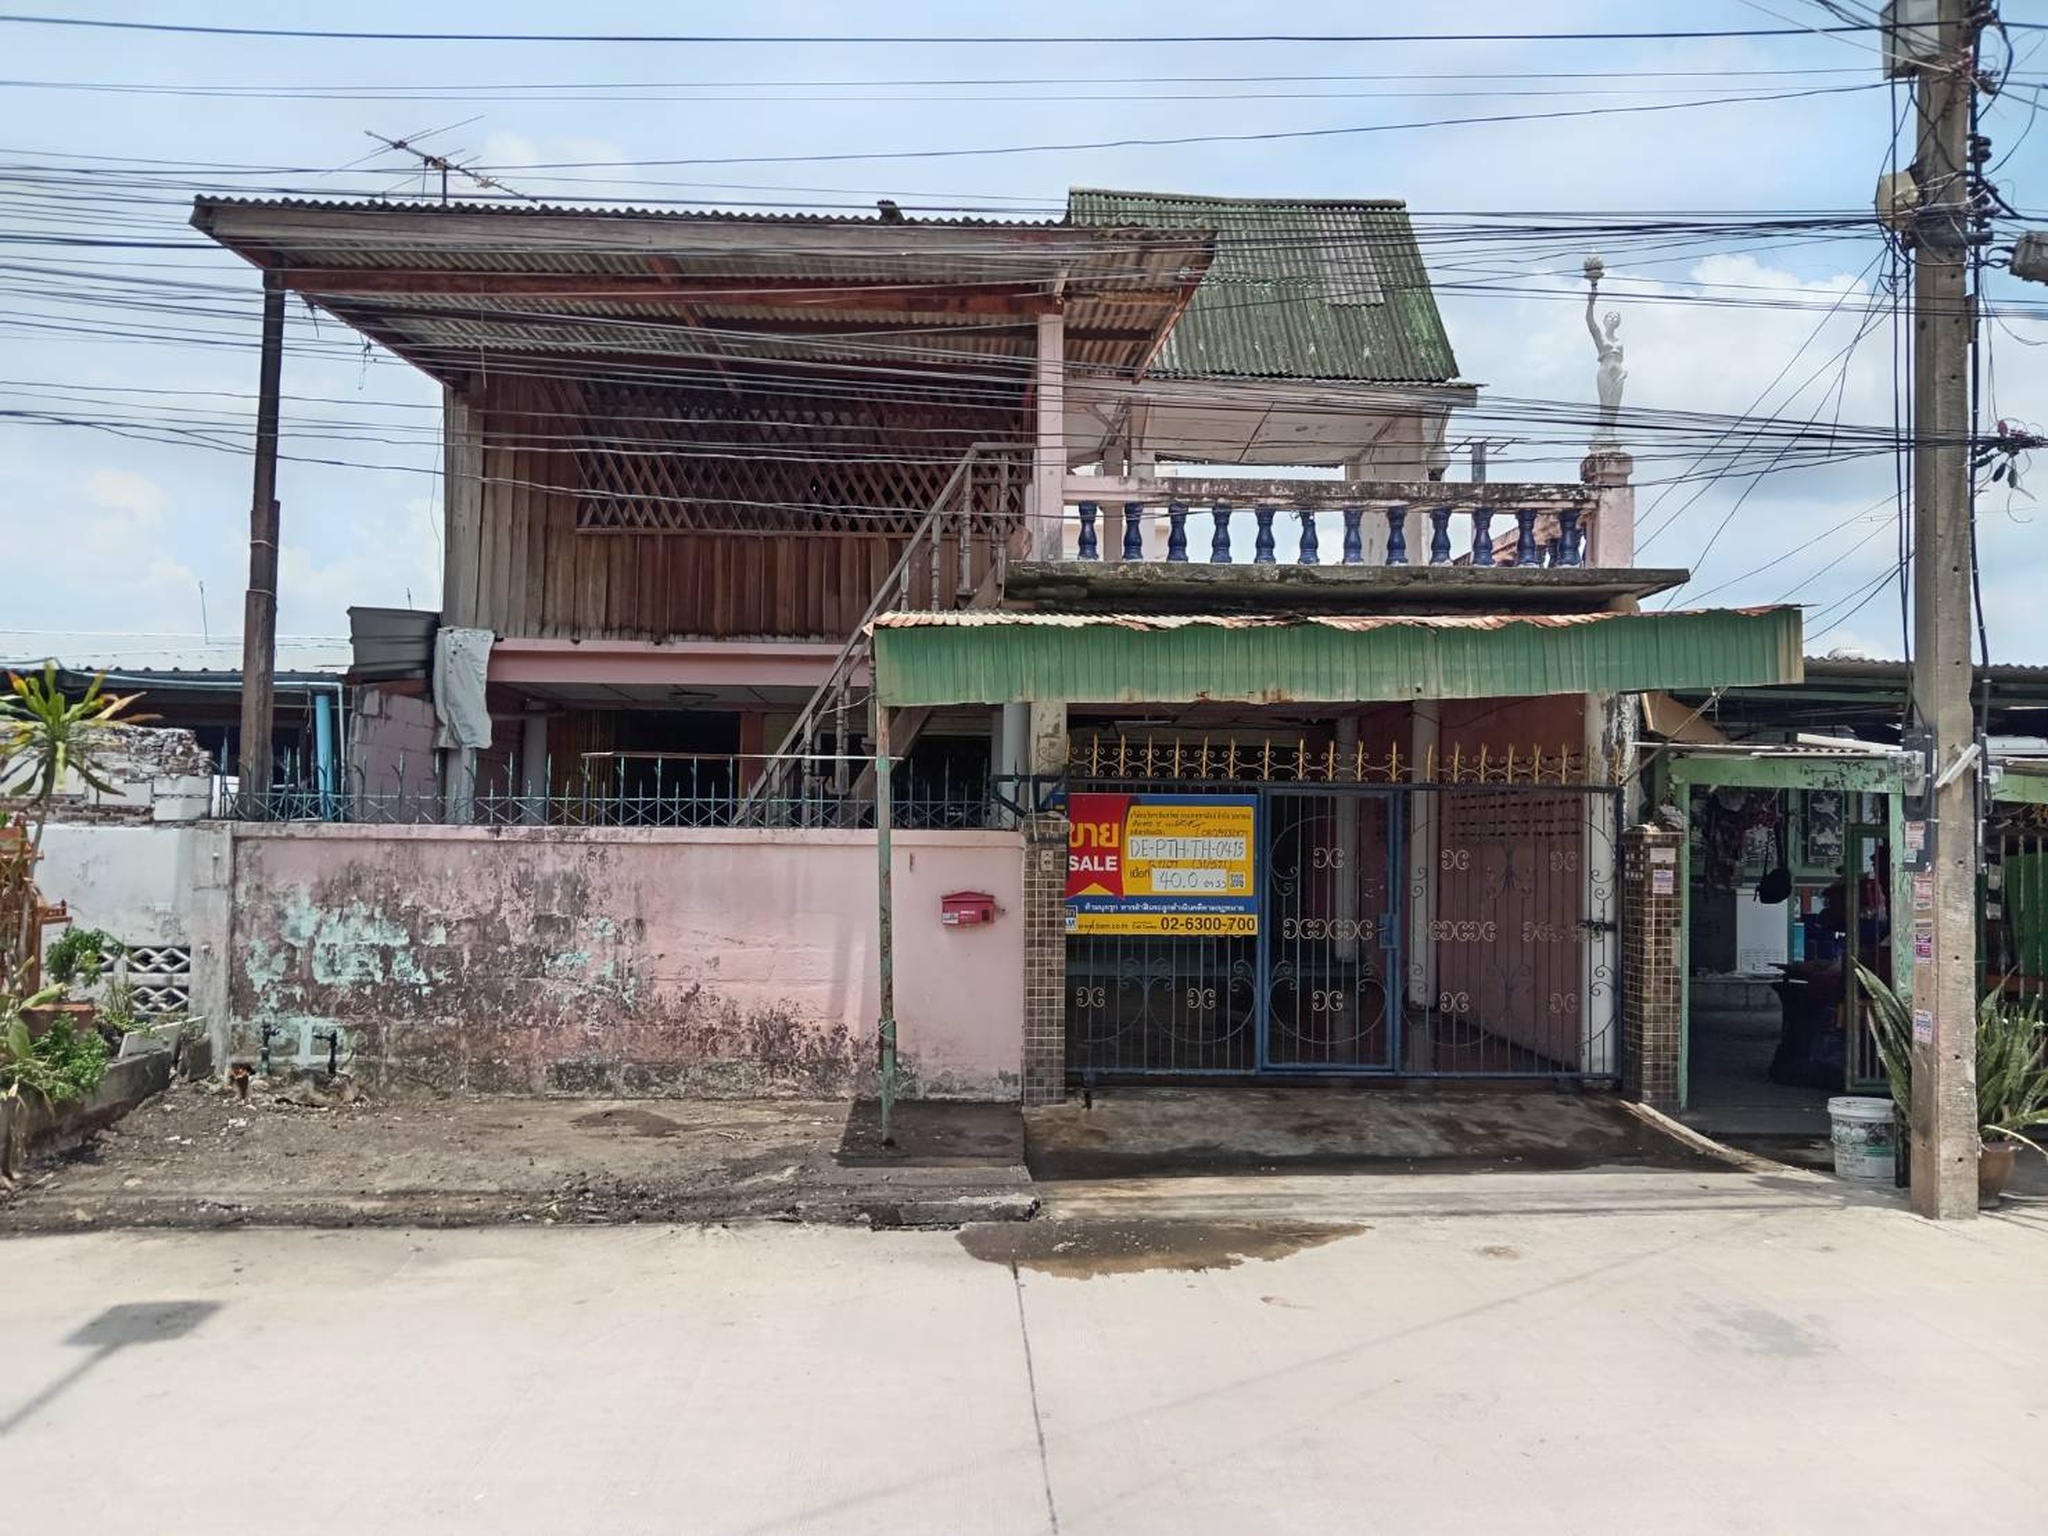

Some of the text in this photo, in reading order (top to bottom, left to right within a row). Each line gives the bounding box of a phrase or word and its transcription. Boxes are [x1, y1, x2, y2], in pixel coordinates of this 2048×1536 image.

[1069, 822, 1120, 848] ขาย
[1069, 855, 1118, 872] SALE
[1159, 870, 1199, 890] 40.0
[1160, 916, 1256, 931] 02-6300-700
